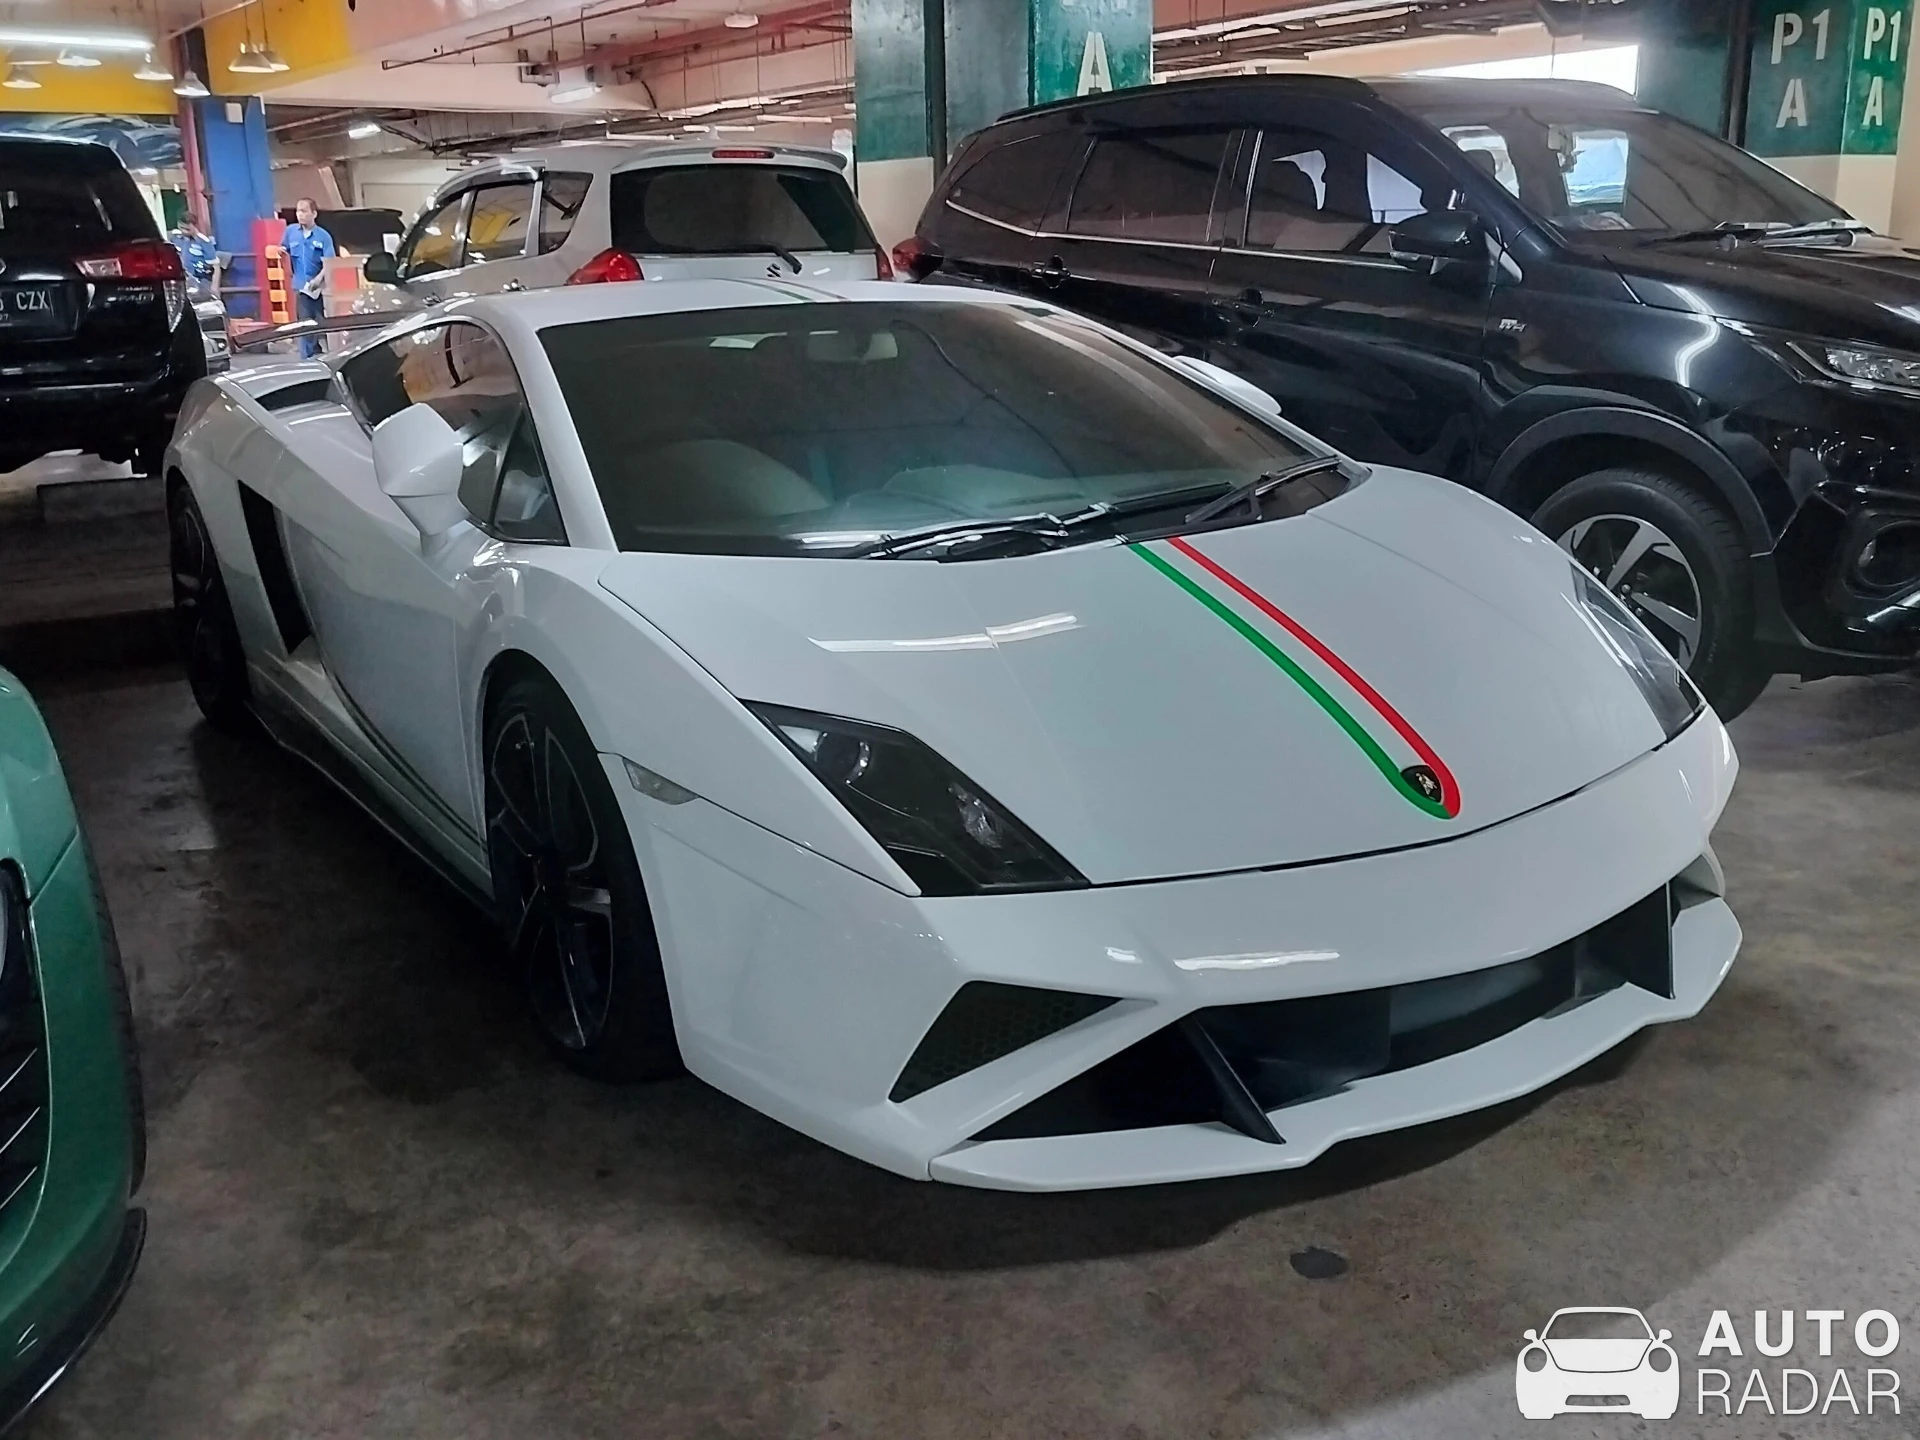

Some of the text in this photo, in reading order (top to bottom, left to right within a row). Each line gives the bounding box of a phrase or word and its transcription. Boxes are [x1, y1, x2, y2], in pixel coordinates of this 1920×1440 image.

[1771, 8, 1830, 65] P1
[1863, 7, 1902, 62] P1
[1076, 31, 1113, 97] A
[1775, 78, 1808, 128] A
[1862, 76, 1883, 126] A
[16, 290, 49, 310] CZX
